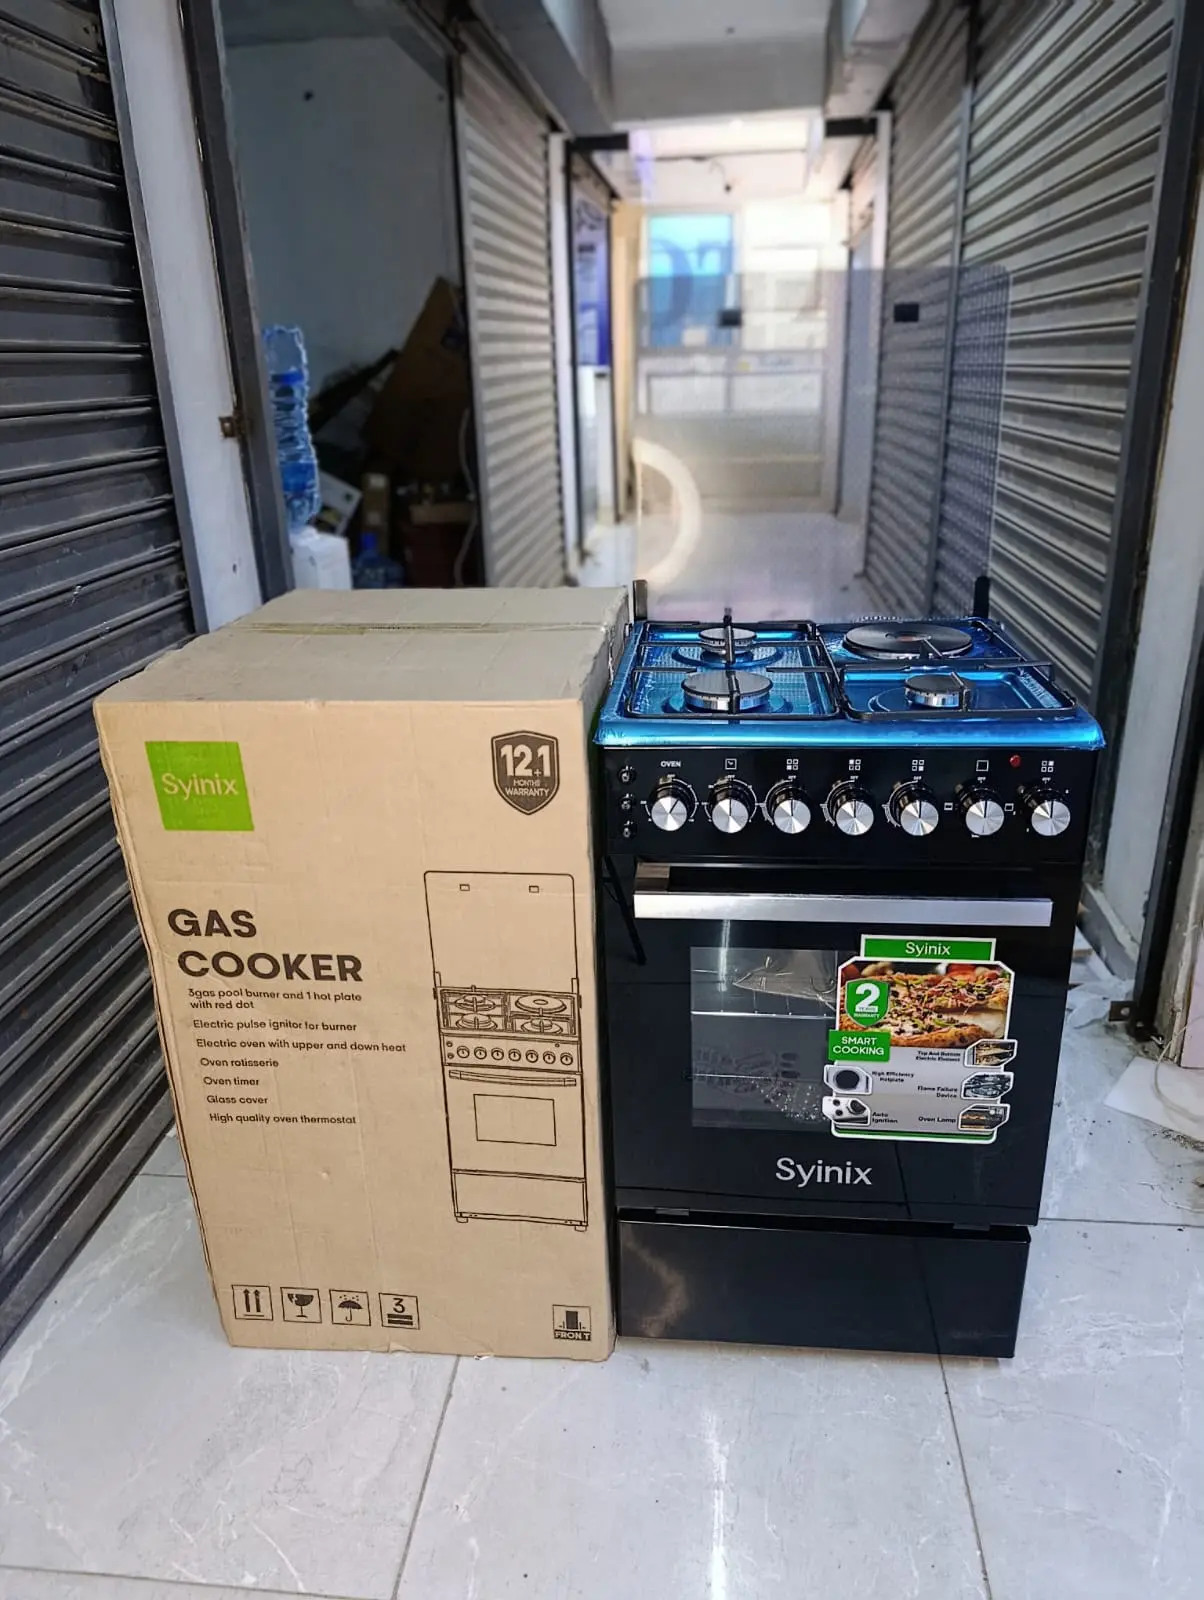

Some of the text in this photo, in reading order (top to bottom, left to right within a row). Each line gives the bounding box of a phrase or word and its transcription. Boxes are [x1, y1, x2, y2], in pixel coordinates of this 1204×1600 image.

[161, 773, 239, 800] Syinix
[505, 787, 550, 797] WARRANTY
[167, 908, 257, 938] GAS
[905, 942, 951, 957] Syinix
[177, 951, 363, 982] COOKER
[188, 988, 362, 1002] 3gas pool burner and 1 hot plate
[855, 982, 880, 1012] 2
[190, 1000, 254, 1009] with red dot
[193, 1020, 357, 1031] Electric pulse ignitor for burner
[196, 1039, 238, 1048] Electric
[268, 1039, 290, 1049] with
[292, 1041, 324, 1051] upper
[327, 1041, 348, 1050] and
[350, 1042, 379, 1051] down
[382, 1042, 407, 1052] heat
[841, 1036, 877, 1045] SMART
[832, 1046, 885, 1056] COOKING
[200, 1057, 279, 1068] Oven rotisserie
[203, 1076, 259, 1086] Oven timer
[206, 1095, 268, 1104] Glass cover
[209, 1113, 234, 1124] High
[236, 1113, 271, 1124] quality
[300, 1115, 356, 1124] thermostat
[775, 1157, 873, 1188] Syinix
[392, 1297, 406, 1314] 3
[555, 1332, 591, 1340] FRONT
